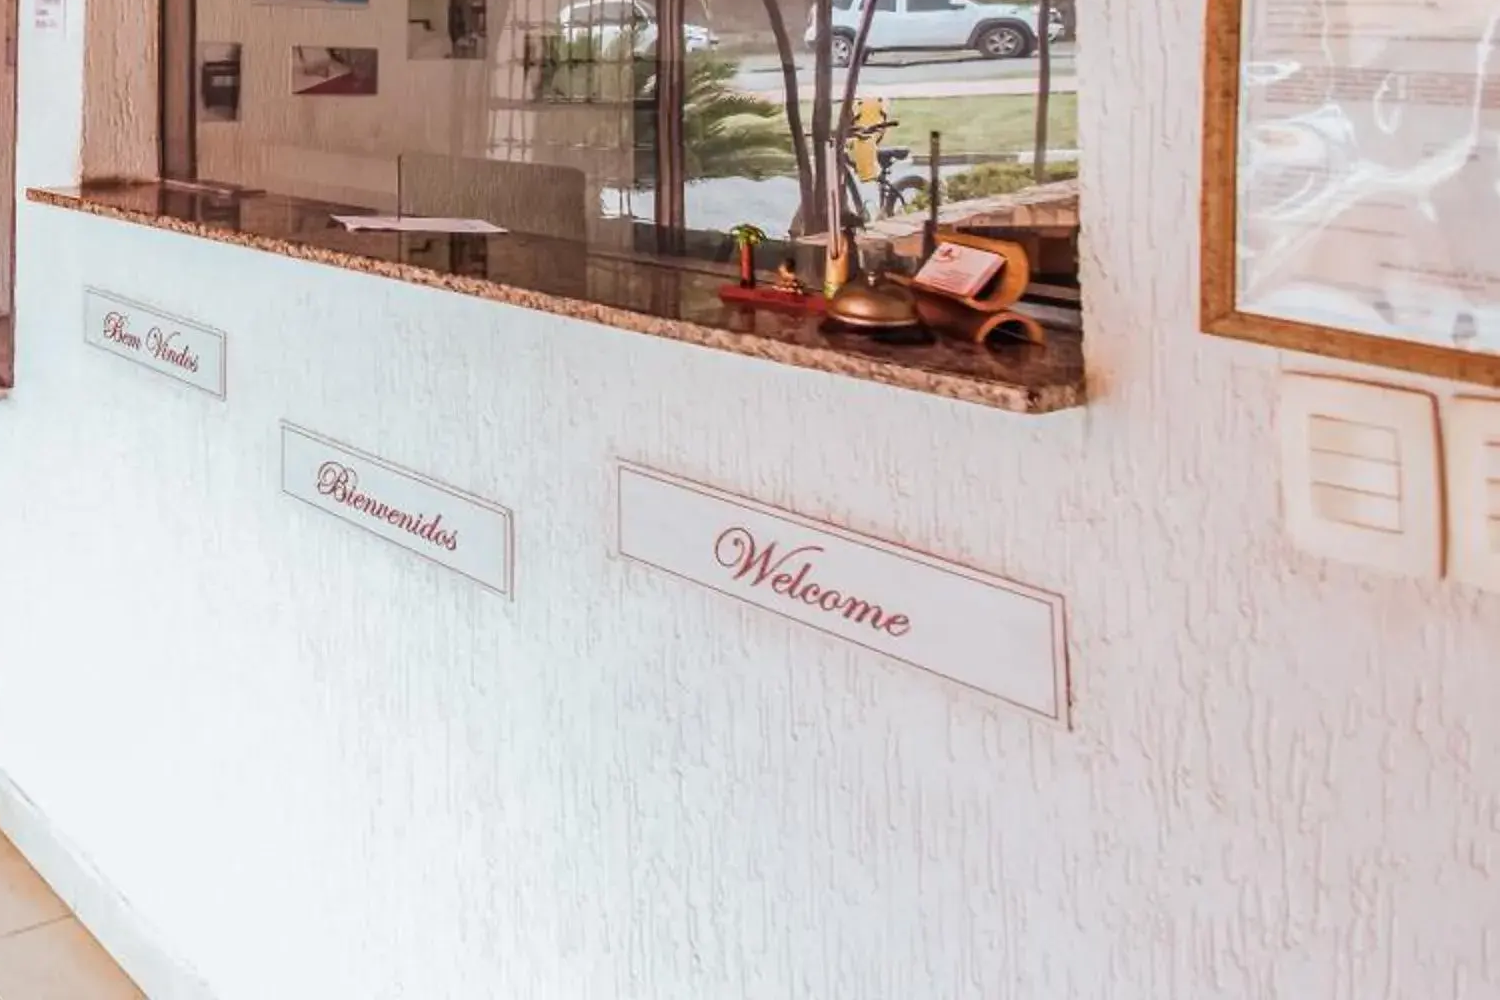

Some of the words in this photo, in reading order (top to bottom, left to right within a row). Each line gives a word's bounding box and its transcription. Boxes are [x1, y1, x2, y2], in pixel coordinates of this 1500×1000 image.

[103, 311, 142, 351] Bem
[145, 326, 199, 374] Vindos
[316, 461, 458, 552] Bienvenidos
[714, 526, 912, 637] Welcome
